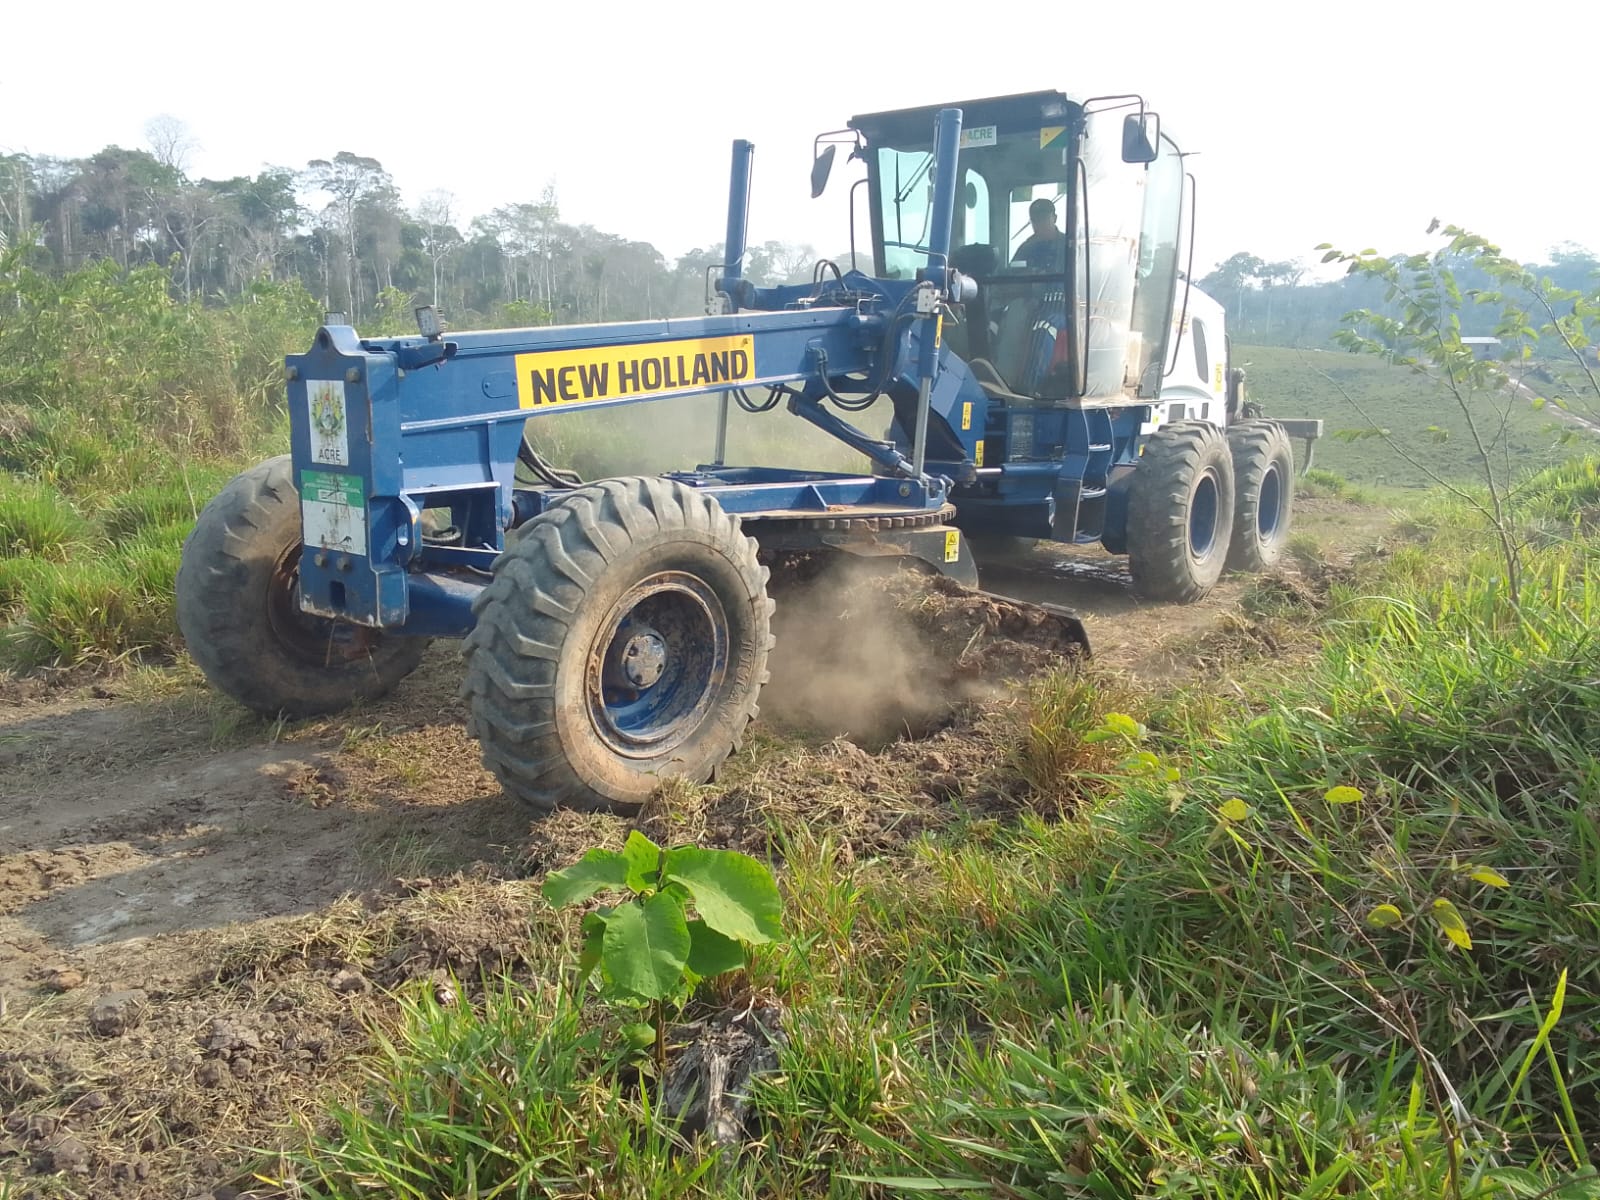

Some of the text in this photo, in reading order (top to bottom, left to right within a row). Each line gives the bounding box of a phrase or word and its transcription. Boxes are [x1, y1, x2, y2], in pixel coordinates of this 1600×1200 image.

[967, 127, 993, 140] ACRE
[530, 349, 749, 405] NEW HOLLAND
[318, 448, 341, 461] ACRE
